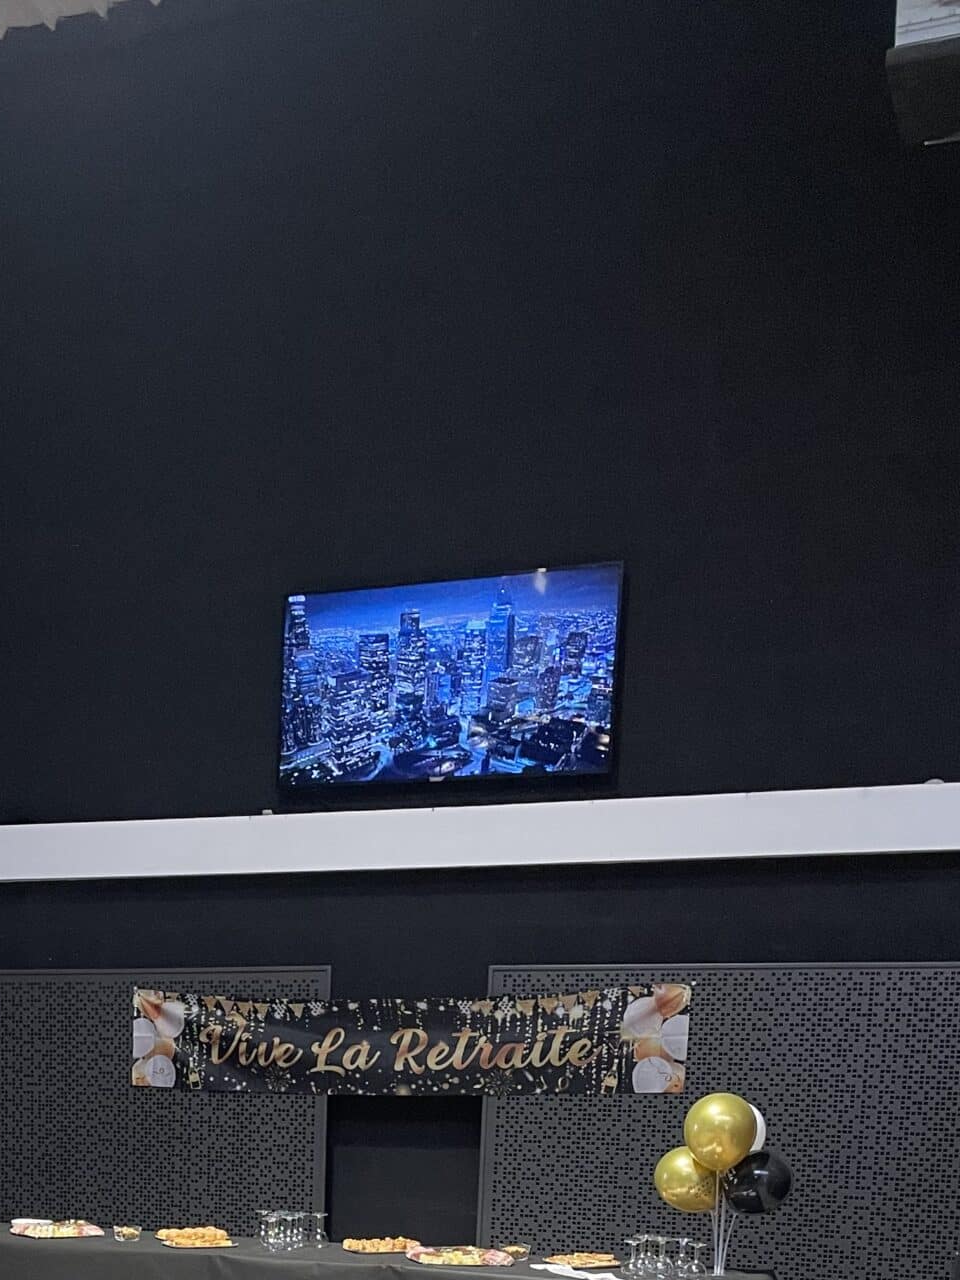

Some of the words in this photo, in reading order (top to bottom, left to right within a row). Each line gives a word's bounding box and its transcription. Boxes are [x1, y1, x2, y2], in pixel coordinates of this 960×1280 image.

[199, 1013, 303, 1067] Vive
[310, 1027, 381, 1077] La
[390, 1025, 602, 1075] Retraite
